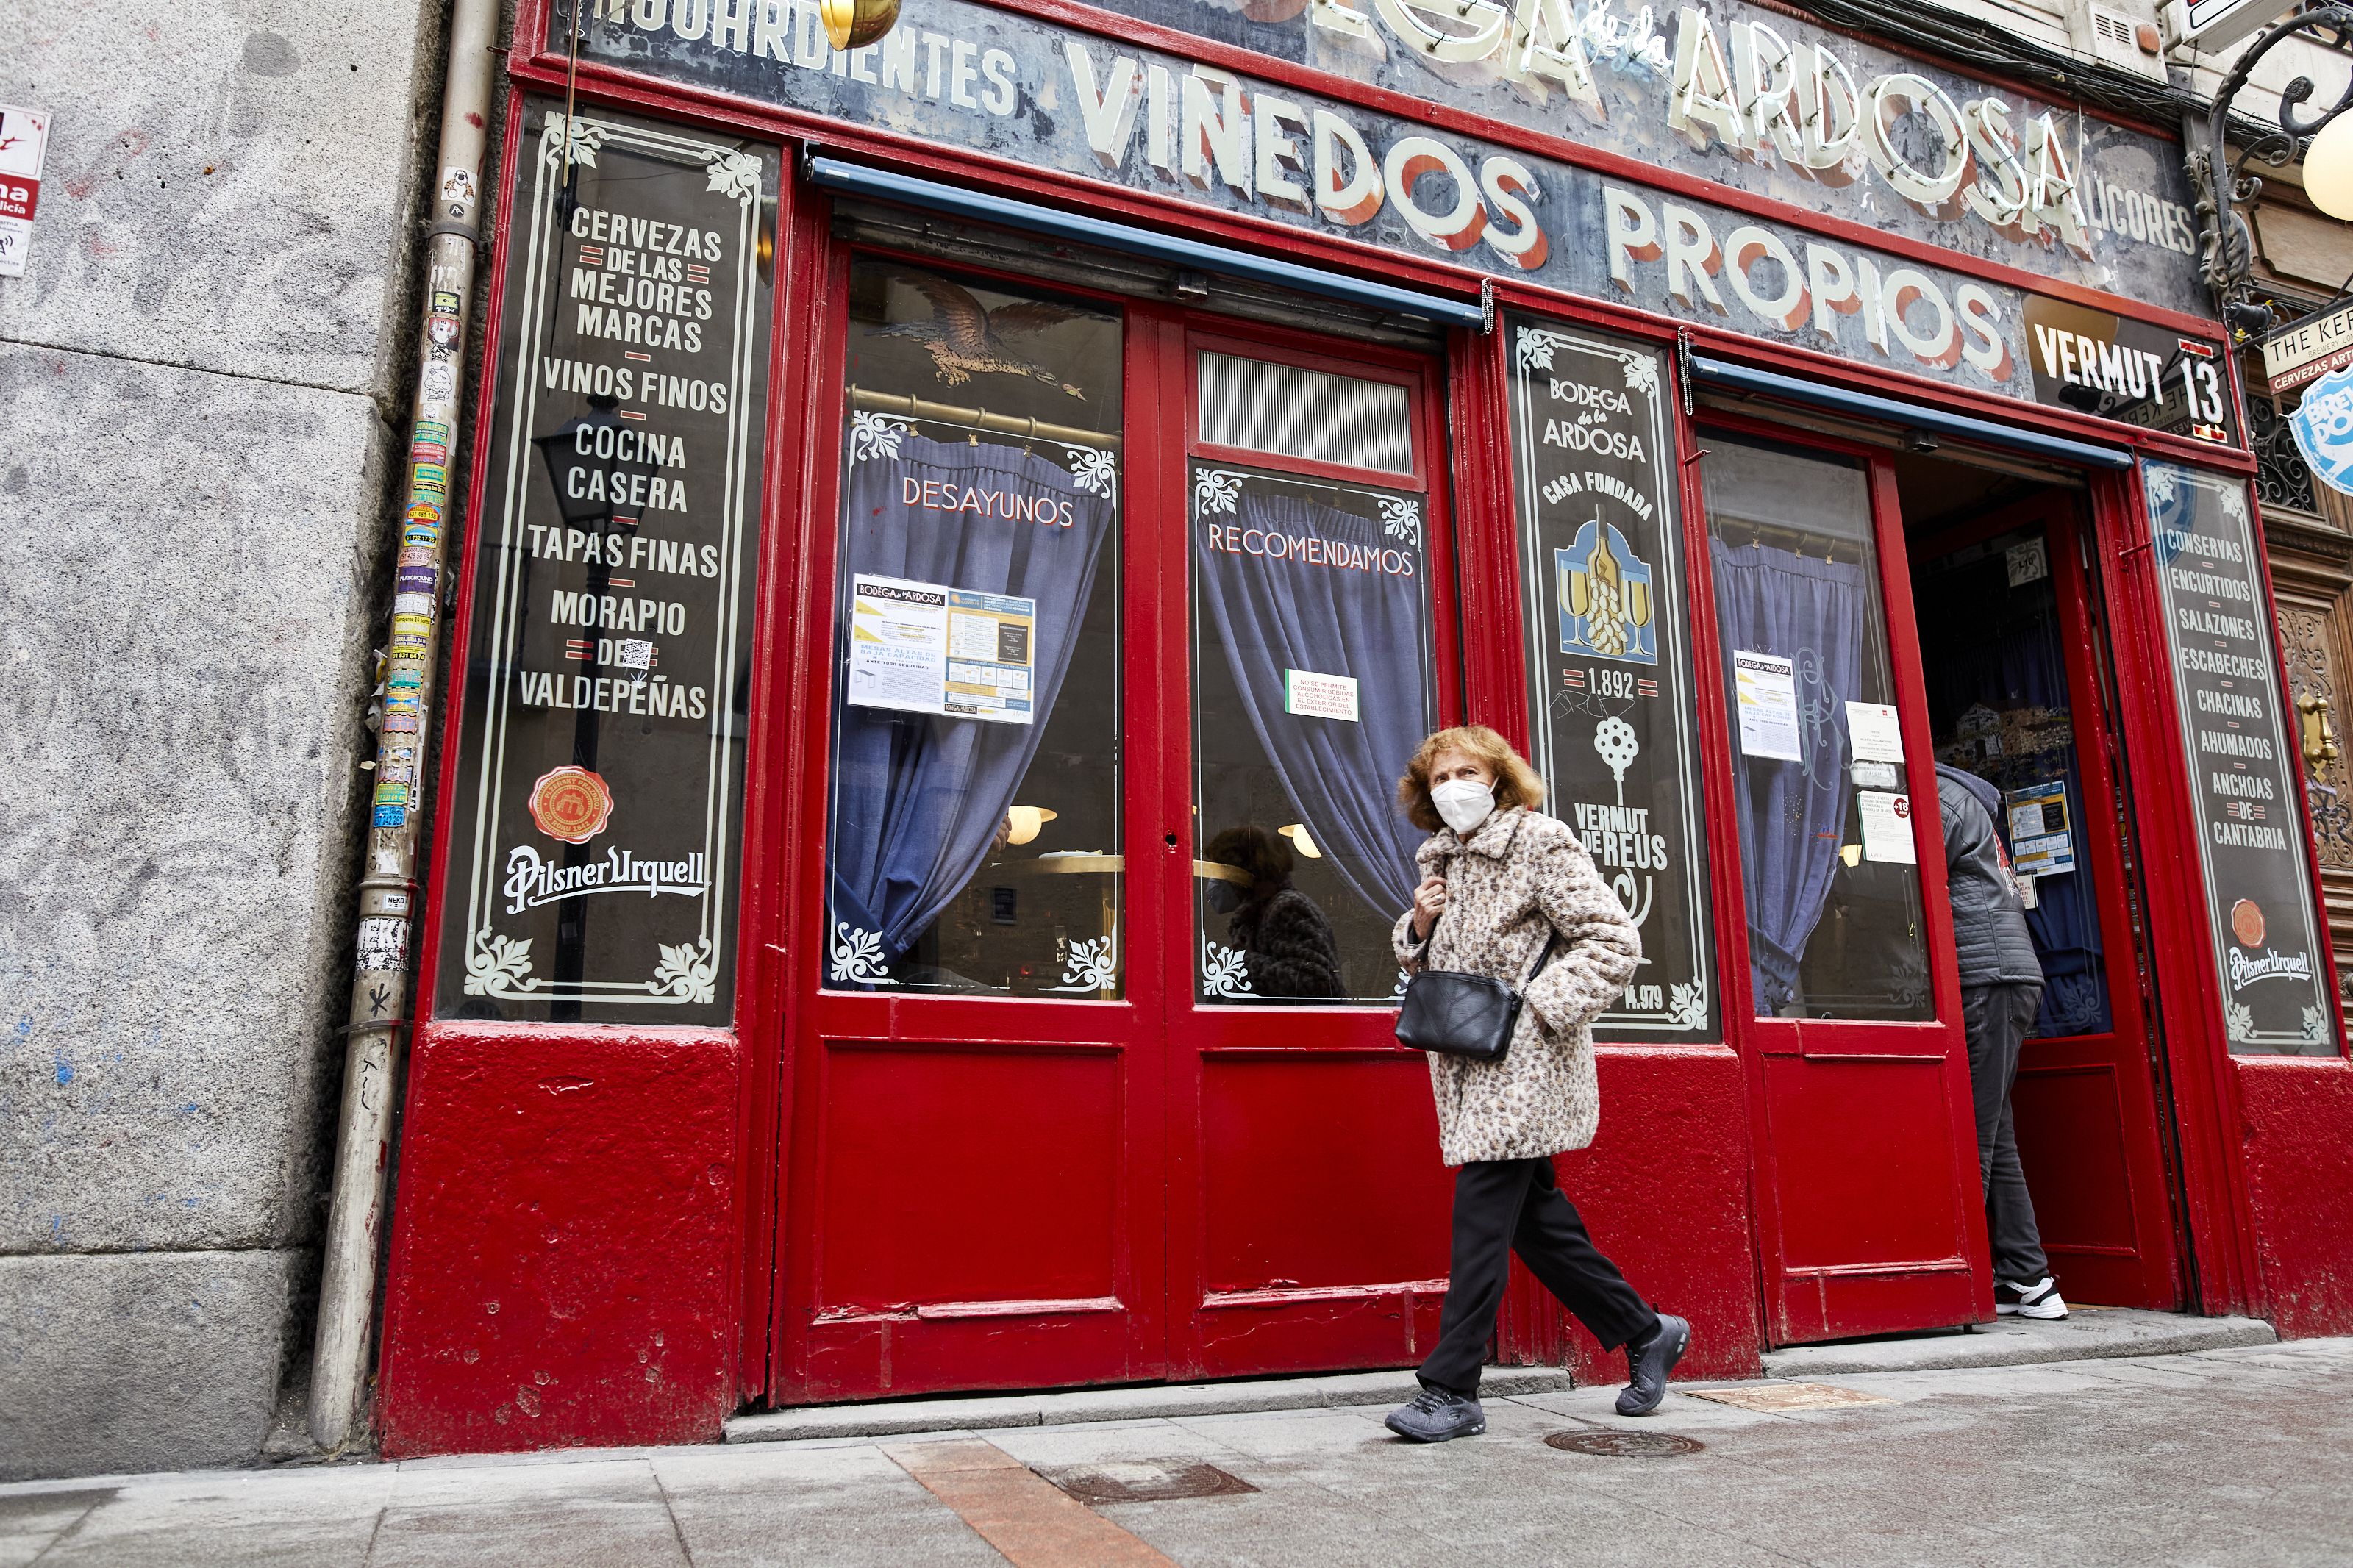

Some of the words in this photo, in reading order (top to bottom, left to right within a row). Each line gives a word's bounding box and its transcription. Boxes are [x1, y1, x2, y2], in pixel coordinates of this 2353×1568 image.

[1667, 5, 2092, 254] ARDOSA
[2083, 175, 2196, 256] LICORES
[571, 207, 721, 262] CERVEZAS
[607, 247, 636, 275] DE
[640, 253, 682, 283] LAS
[571, 267, 713, 321] MEJORES
[1604, 186, 2009, 379] PROPIOS
[576, 304, 701, 353] MARCAS
[2270, 329, 2311, 361] THE
[2308, 339, 2339, 358] BREWERY
[543, 357, 633, 400] VINOS
[640, 371, 727, 415] FINOS
[2034, 323, 2164, 405] VERMUT
[2180, 357, 2224, 424] 13
[2274, 360, 2328, 390] CERVEZAS
[1549, 377, 1632, 415] BODEGA
[1577, 410, 1593, 426] de
[1593, 409, 1608, 423] la
[575, 423, 687, 469] COCINA
[1543, 418, 1646, 464] ARDOSA
[568, 466, 688, 512] CASERA
[903, 476, 1074, 529] DESAYUNOS
[1542, 471, 1583, 505] CASA
[1584, 471, 1654, 522] FUNDADA
[527, 524, 624, 568] TAPAS
[629, 537, 718, 579] FINAS
[1208, 523, 1413, 577] RECOMENDAMOS
[2018, 557, 2033, 568] L10
[2167, 528, 2243, 564] CONSERVAS
[399, 575, 433, 583] PLAYGROUND
[860, 584, 896, 598] BODEGA
[904, 592, 943, 604] ARDOSA
[2170, 568, 2251, 603] ENCURTIDOS
[551, 590, 686, 636] MORAPIO
[2179, 607, 2255, 641] SALAZONES
[597, 637, 626, 667] DE
[860, 644, 893, 652] MESAS
[2181, 647, 2266, 681] ESCABECHES
[520, 671, 707, 720] VALDEPEÑAS
[1293, 684, 1327, 694] CONSUMIR
[1327, 689, 1354, 698] BEBIDAS
[1320, 682, 1347, 690] PERMITE
[1588, 667, 1635, 700] 1.892
[1296, 704, 1352, 715] ESTABLECIMIENTO
[1307, 698, 1337, 707] EXTERIOR
[2196, 688, 2263, 720] CHACINAS
[2201, 730, 2273, 761] AHUMADOS
[2213, 771, 2274, 801] ANCHOAS
[1574, 802, 1649, 835] VERMUT
[1893, 801, 1909, 812] +18
[2238, 801, 2254, 821] DE
[1580, 830, 1602, 854] DE
[1604, 832, 1668, 871] REUS
[2213, 821, 2287, 851] CANTABRIA
[503, 845, 610, 915] Pilsner
[607, 845, 704, 898] Urquell
[388, 896, 404, 904] NEKO
[2229, 946, 2271, 991] Pilsner
[2267, 947, 2310, 981] Urquell
